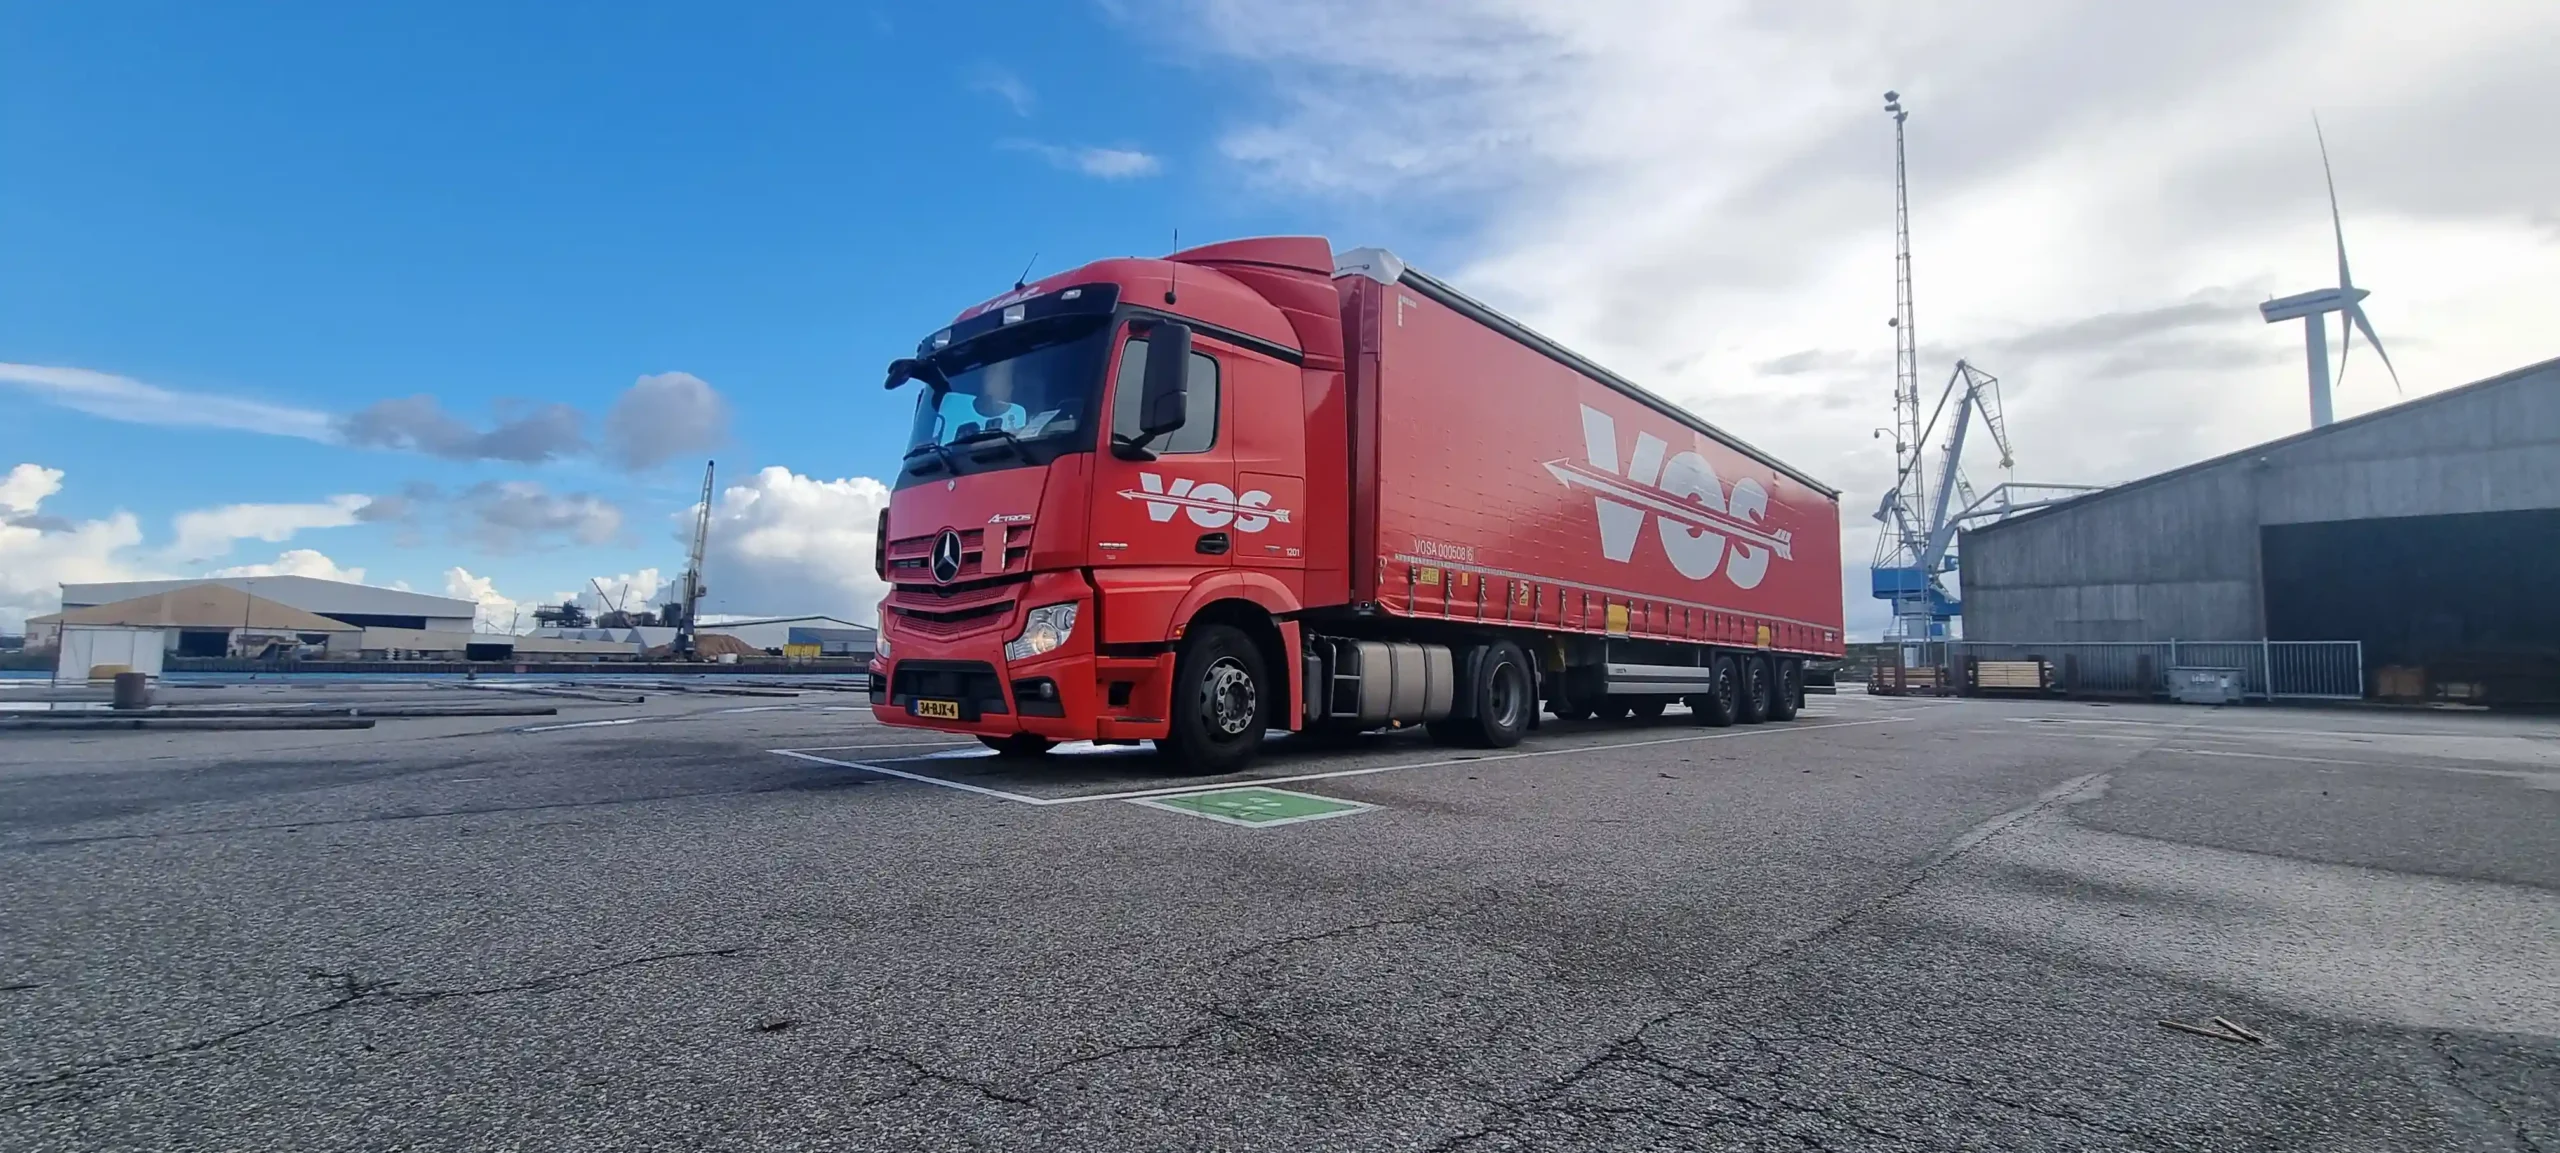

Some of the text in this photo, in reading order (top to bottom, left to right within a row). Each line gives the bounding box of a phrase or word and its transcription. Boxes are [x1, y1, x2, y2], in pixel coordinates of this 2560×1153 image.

[1140, 472, 1272, 533] VOS
[1580, 403, 1770, 589] VOS
[1414, 539, 1437, 556] VOSA
[1438, 543, 1466, 561] 000508
[920, 701, 955, 717] 34-BJX-4
